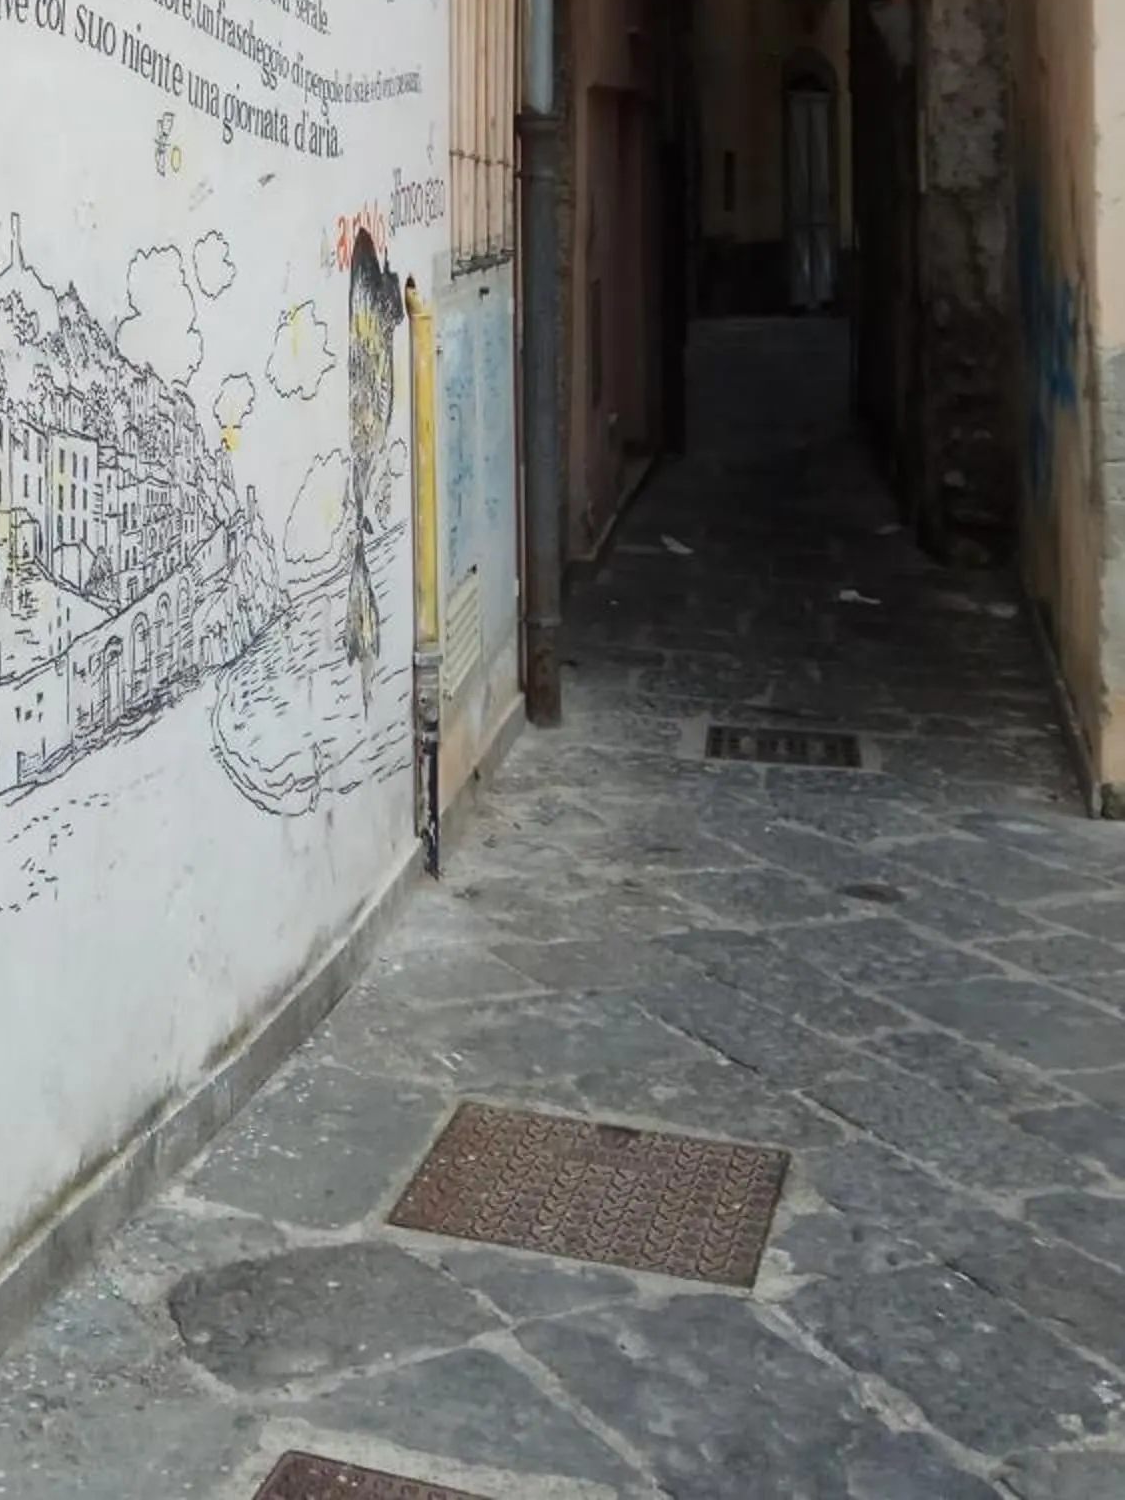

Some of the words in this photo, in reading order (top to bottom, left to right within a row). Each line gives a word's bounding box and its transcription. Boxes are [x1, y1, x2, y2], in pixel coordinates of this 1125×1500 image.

[74, 3, 116, 57] suo
[123, 22, 183, 97] niente
[187, 70, 220, 119] una
[222, 84, 289, 145] giornata
[196, 0, 214, 37] un
[291, 51, 305, 88] di
